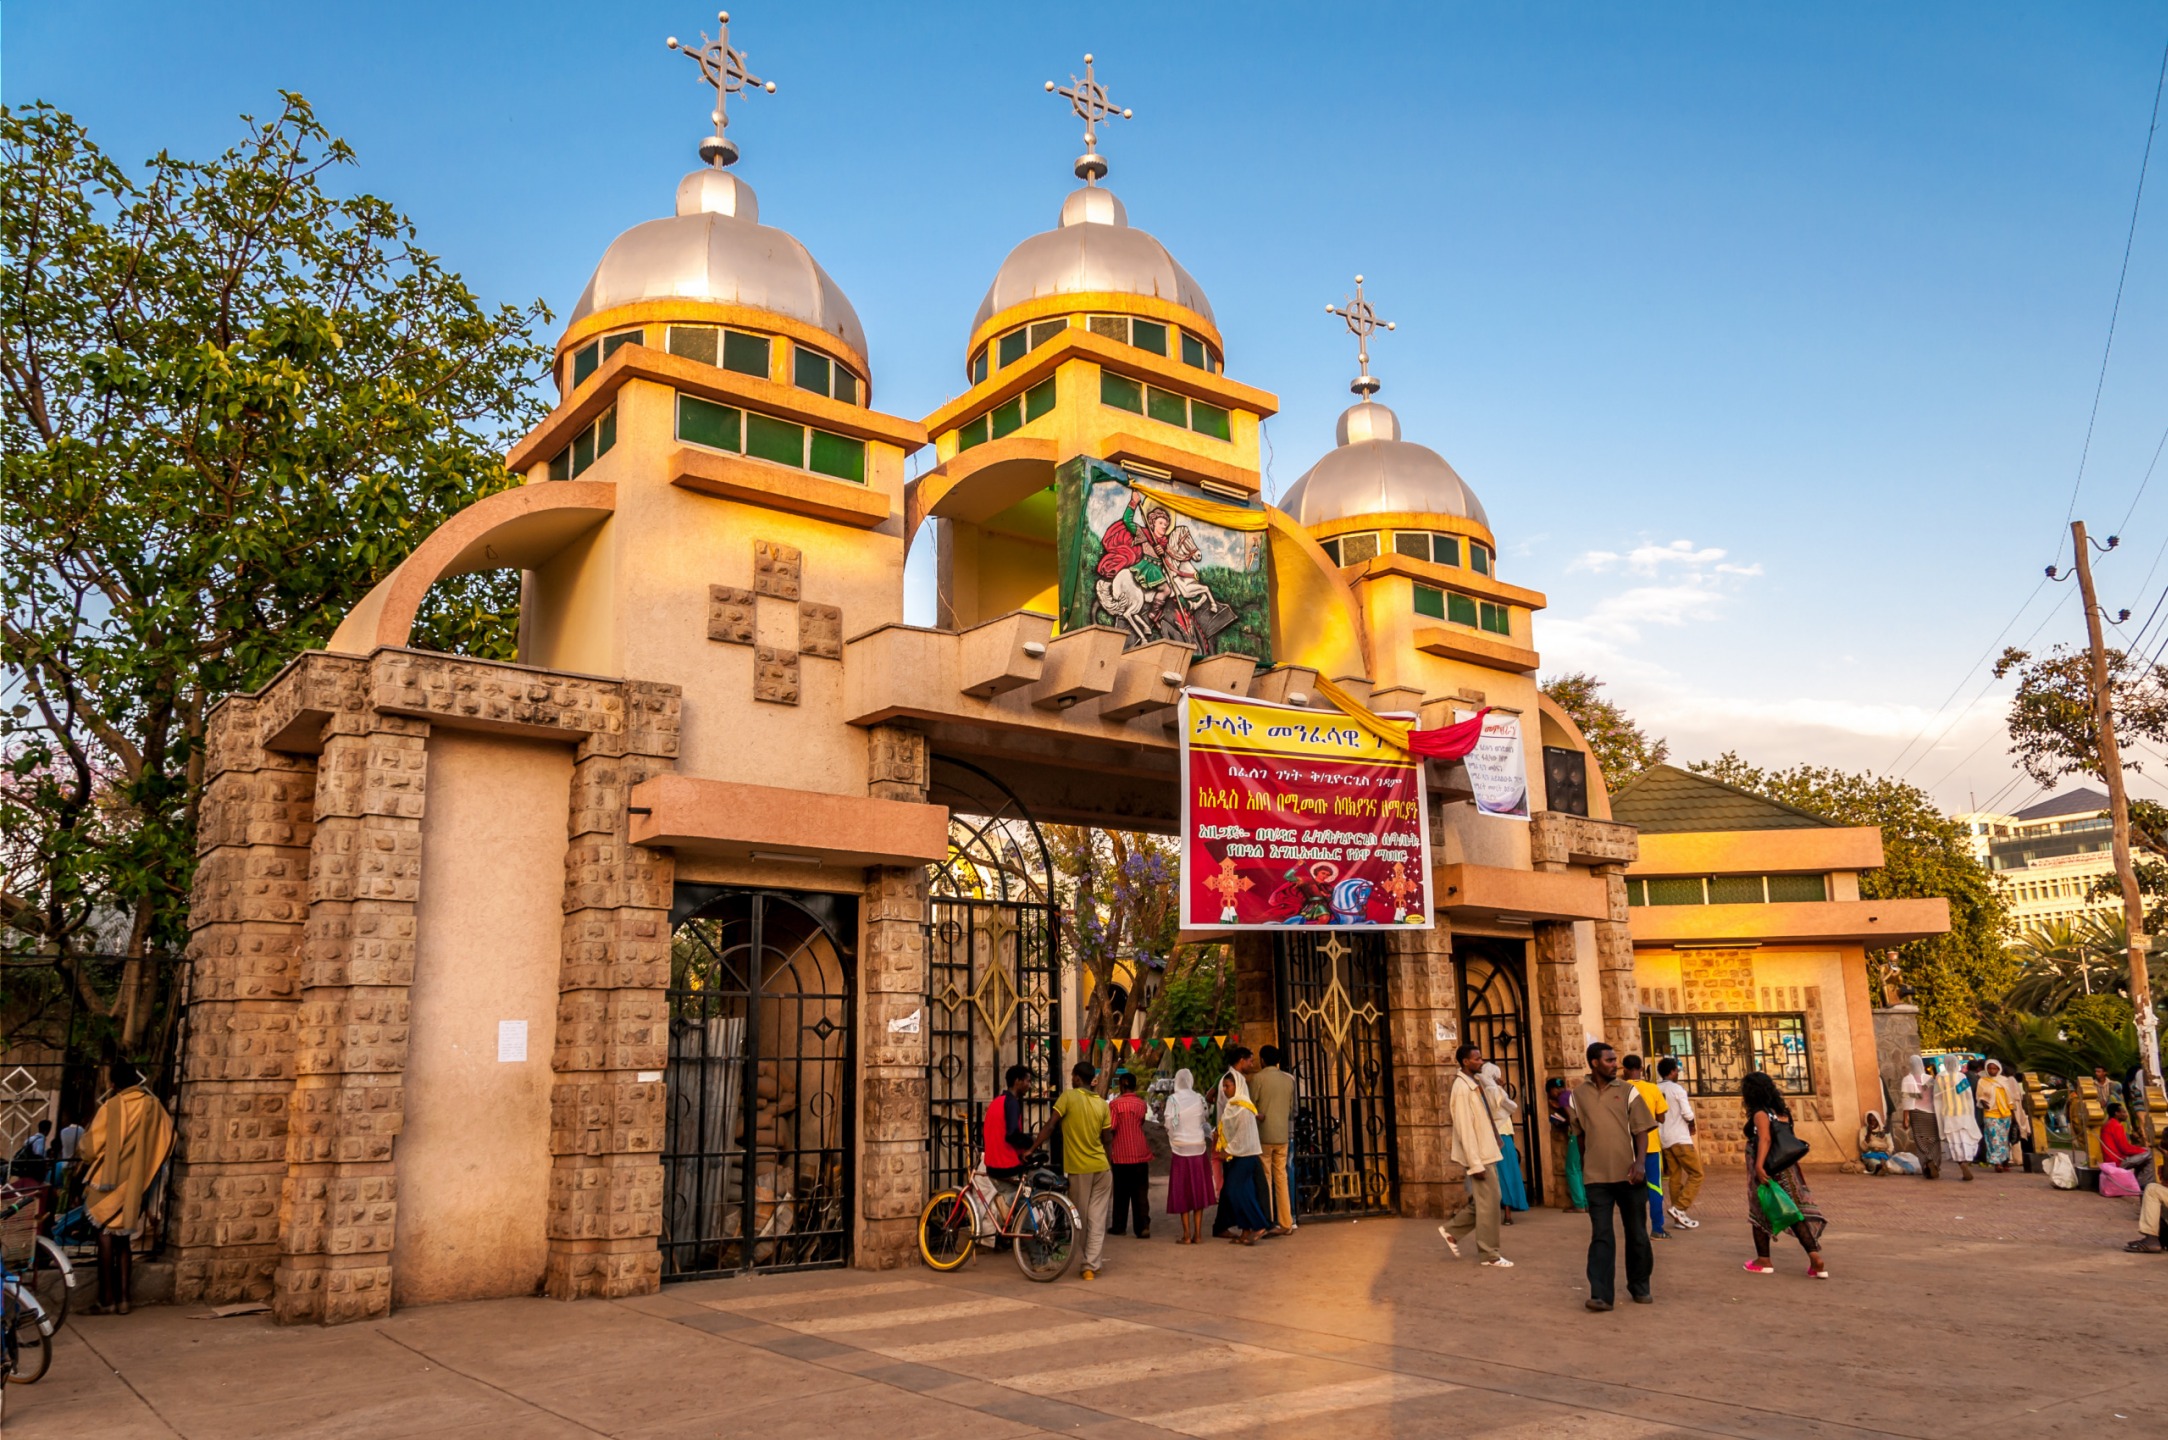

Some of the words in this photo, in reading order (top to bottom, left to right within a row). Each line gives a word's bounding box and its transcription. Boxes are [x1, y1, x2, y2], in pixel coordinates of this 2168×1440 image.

[1196, 714, 1253, 736] ታላቅ
[1267, 724, 1360, 748] መንፈሳዊ
[1228, 766, 1268, 779] በፈለገ
[1275, 769, 1303, 781] ገነት
[1310, 771, 1370, 787] ቅ/ጊዮርጊስ
[1376, 778, 1403, 788] ገዳም
[1199, 786, 1239, 810] ከአዲስ
[1246, 789, 1272, 812] አበባ
[1276, 793, 1329, 815] በሚመጡ
[1381, 799, 1419, 820] ዘማርያን
